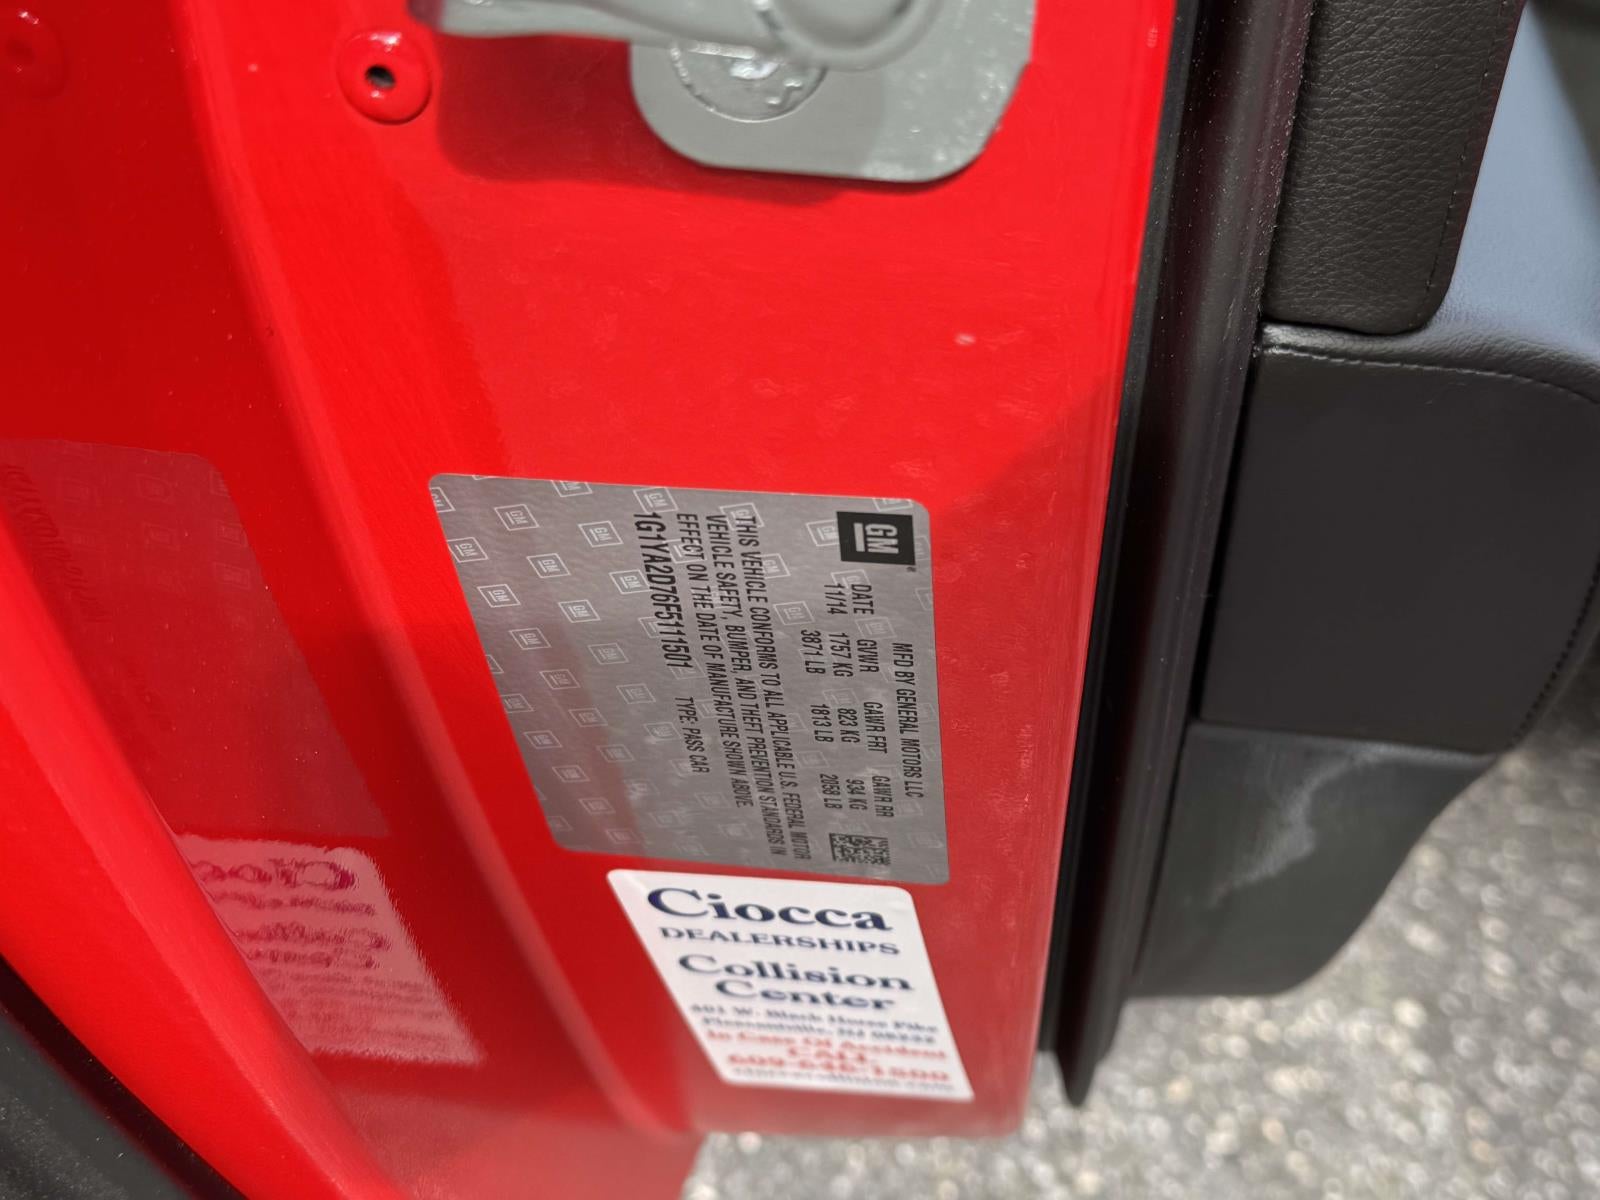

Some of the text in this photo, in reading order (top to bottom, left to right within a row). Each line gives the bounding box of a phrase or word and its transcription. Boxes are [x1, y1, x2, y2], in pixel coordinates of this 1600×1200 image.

[677, 513, 705, 560] EFFECT
[735, 516, 760, 547] THIS
[866, 523, 900, 555] GM
[686, 564, 709, 581] ON
[741, 552, 768, 603] VEHICLE
[690, 585, 714, 609] THE
[824, 583, 849, 615] 11/14
[851, 584, 875, 615] DATE
[633, 512, 711, 773] 1G1YA2D76F5111501 TYPE: PASS CAR
[695, 612, 721, 642] DATE
[750, 607, 778, 670] CONFORMS
[702, 644, 724, 660] OF
[801, 629, 826, 674] 3871 LB
[829, 632, 854, 677] 1757 KG
[856, 639, 880, 673] GVWR
[706, 515, 788, 856] VEHICLE SAFETY, BUMPER, AND THEFT PREVENTION STANDARDS IN
[760, 673, 781, 687] TO
[705, 662, 740, 739] MANUFACTURE
[763, 689, 785, 708] ALL
[810, 703, 834, 743] 1813 LB
[837, 708, 861, 743] 823 KG
[863, 701, 888, 754] GAWR FRT
[891, 642, 924, 798] MFD BY GENERAL MOTORS LLC
[723, 740, 748, 776] SHOWN
[767, 711, 796, 769] APPLICABLE
[820, 773, 843, 809] 2058 LB
[845, 779, 868, 810] 934 KG
[872, 775, 894, 817] GAWR RR
[782, 791, 805, 828] FEDERAL
[790, 831, 812, 860] MOTOR
[647, 887, 893, 931] Ciocca
[660, 926, 901, 956] DEALERSHIPS
[678, 953, 914, 991] Collision
[715, 979, 897, 1011] Center
